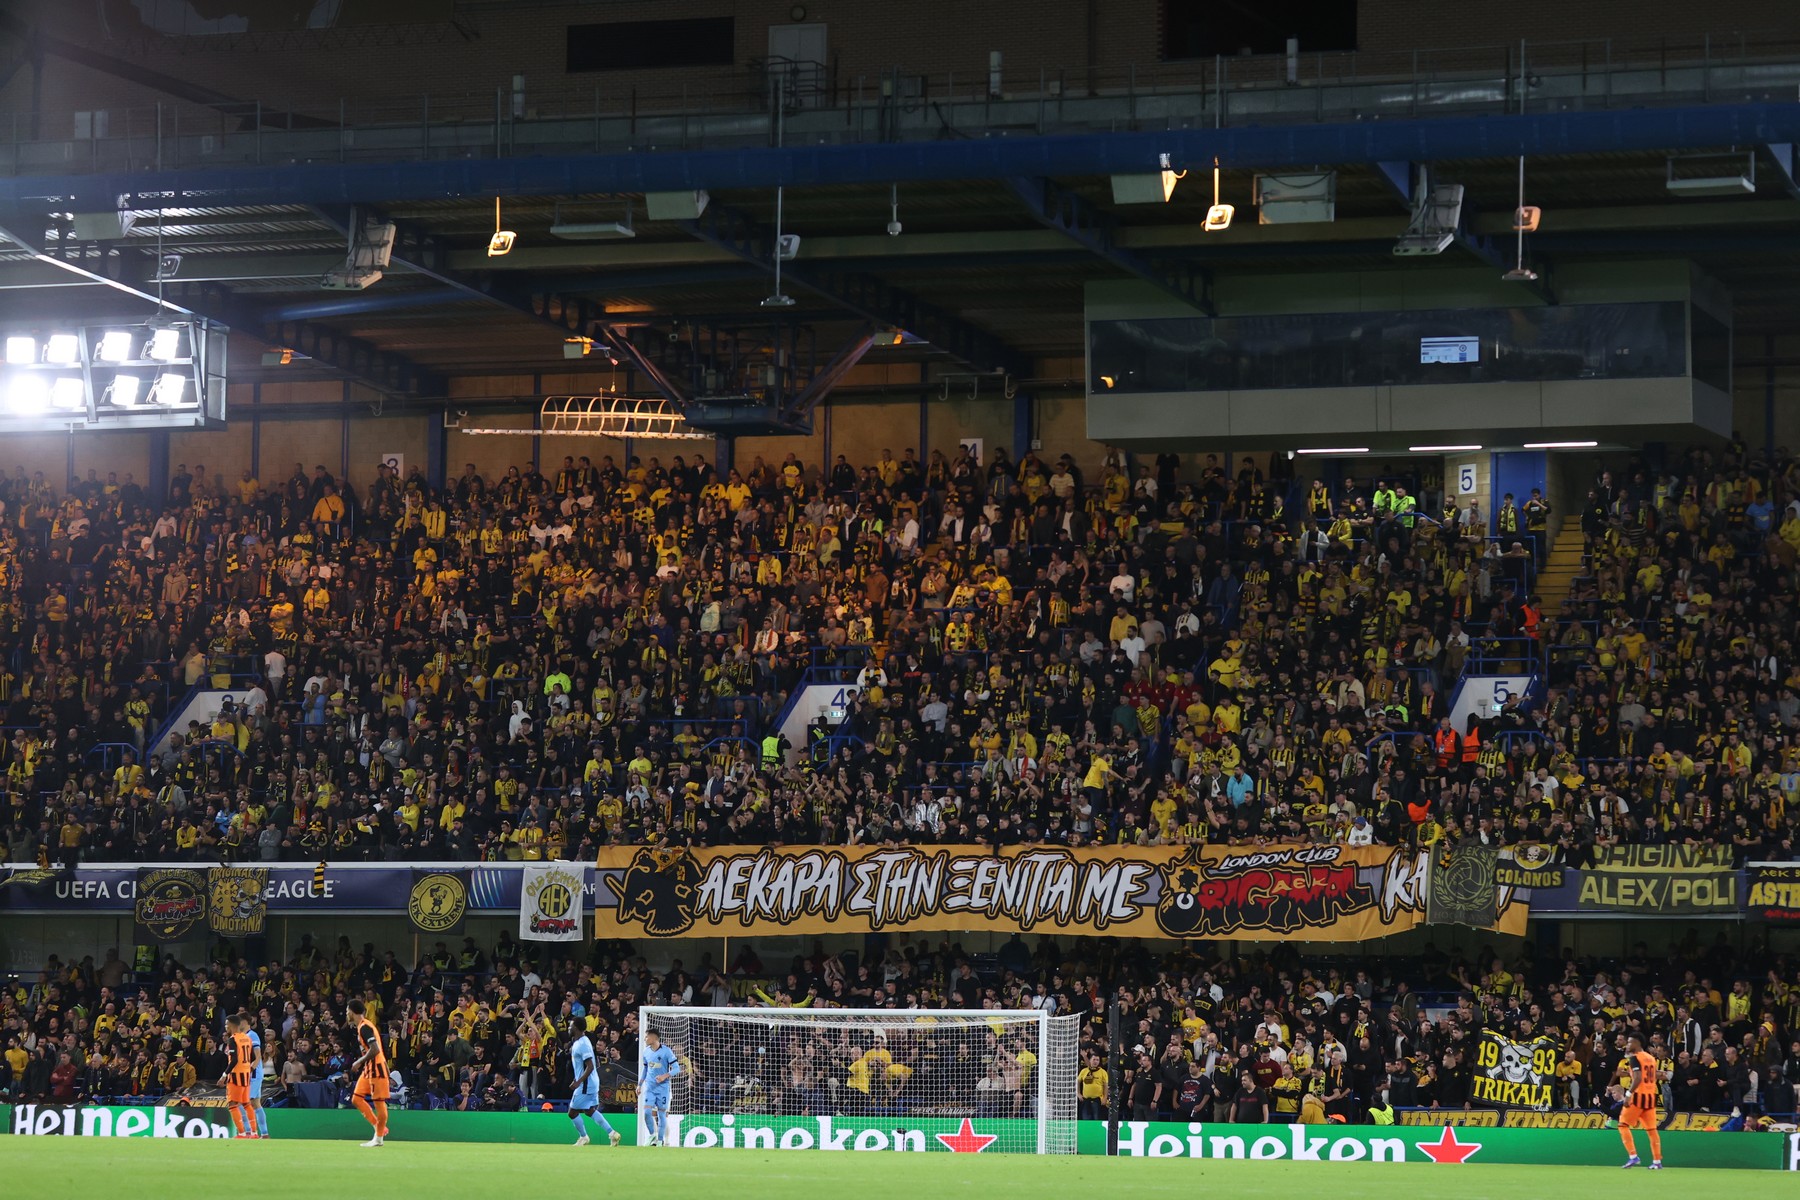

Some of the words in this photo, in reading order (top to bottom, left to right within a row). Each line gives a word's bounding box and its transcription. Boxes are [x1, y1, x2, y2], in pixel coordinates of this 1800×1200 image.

[1461, 469, 1473, 491] 5
[831, 688, 846, 710] 4
[1493, 681, 1510, 704] 5
[1219, 851, 1291, 870] LONDON
[1294, 847, 1340, 862] CLUB
[55, 880, 110, 899] UEFA
[266, 880, 334, 898] EAGUE
[1495, 869, 1562, 887] COLONOS
[539, 884, 570, 918] AEK
[1579, 876, 1736, 911] ALEX/POLI
[1473, 1075, 1552, 1107] TRIKALA
[15, 1104, 229, 1138] Heineken
[1401, 1111, 1498, 1127] UNITED
[1504, 1111, 1607, 1130] KINGDO
[1667, 1113, 1732, 1132] AEK
[1102, 1120, 1406, 1162] Heineken
